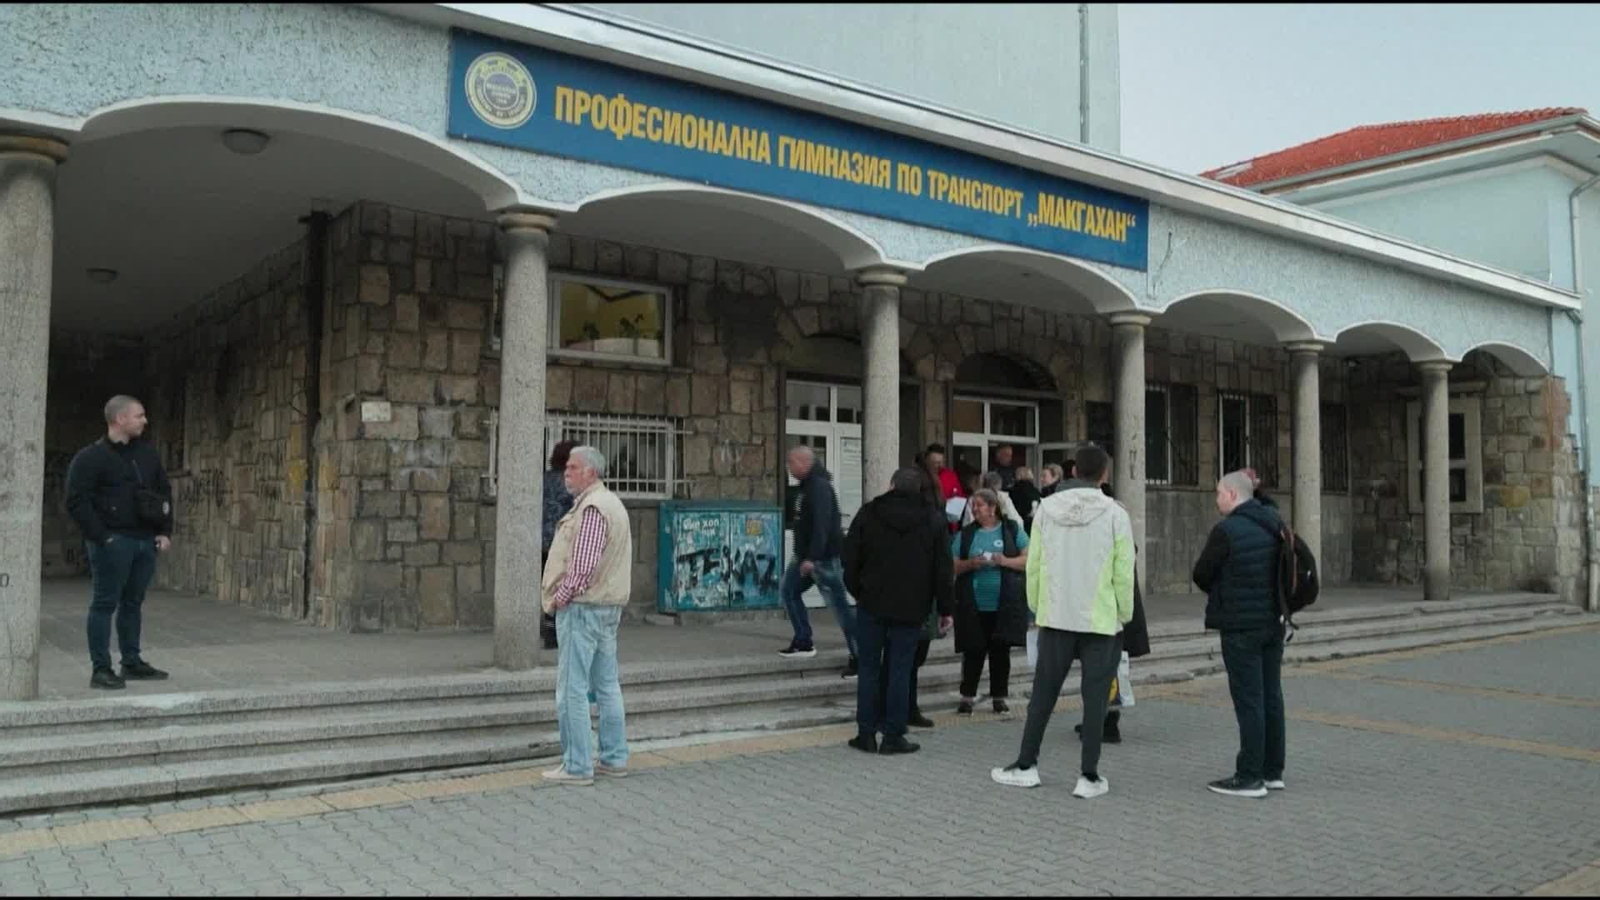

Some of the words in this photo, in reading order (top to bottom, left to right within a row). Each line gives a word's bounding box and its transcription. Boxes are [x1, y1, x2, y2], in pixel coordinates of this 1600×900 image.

[554, 85, 771, 164] ПРОФЕСИОНАЛНА
[777, 135, 892, 189] ГИМНАЗИЯ
[896, 162, 923, 196] ПО
[927, 169, 1024, 218] ТРАНСПОРТ
